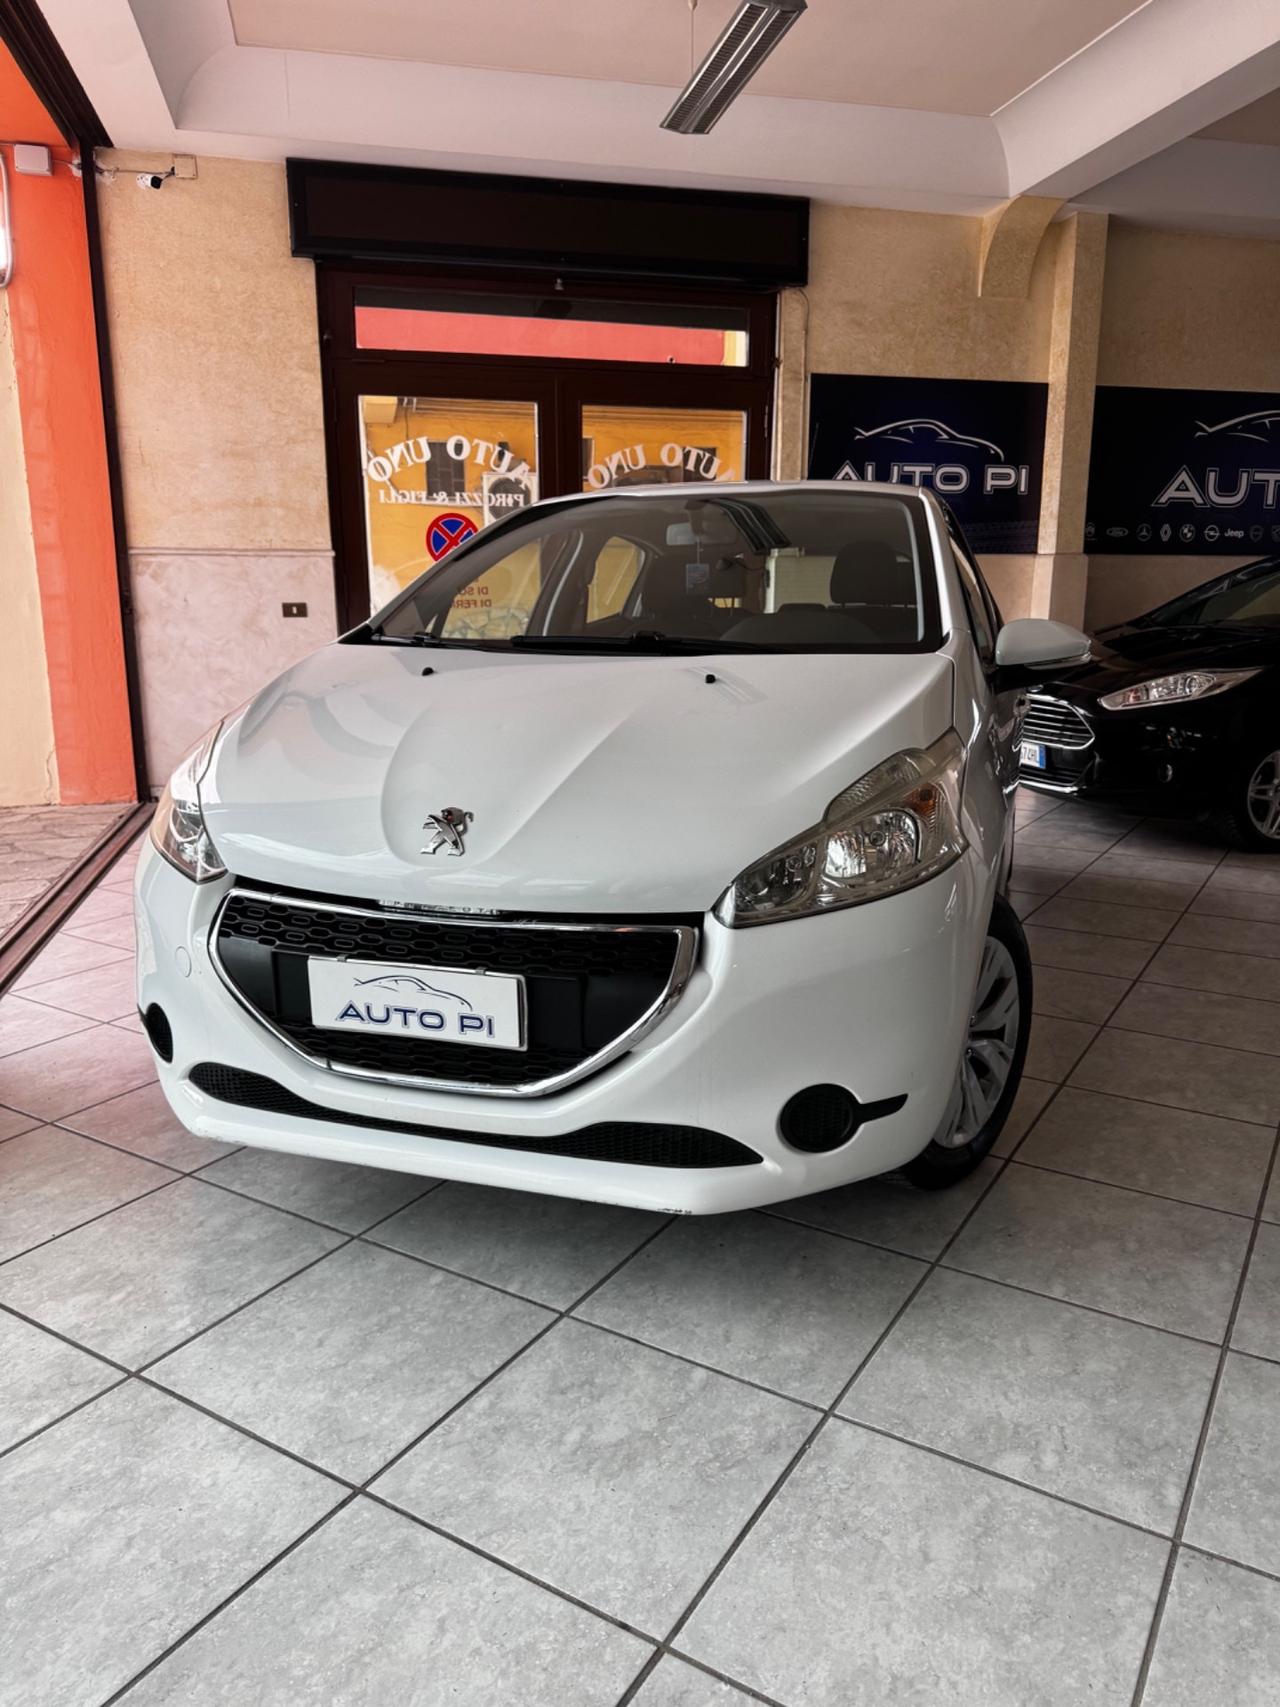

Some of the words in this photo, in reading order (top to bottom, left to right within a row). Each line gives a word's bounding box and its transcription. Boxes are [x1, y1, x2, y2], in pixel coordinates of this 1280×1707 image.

[832, 460, 970, 494] AUTO
[983, 464, 1029, 495] PI
[1224, 528, 1244, 539] Jeep
[336, 1000, 446, 1031] AUTO
[458, 1013, 495, 1038] PI
